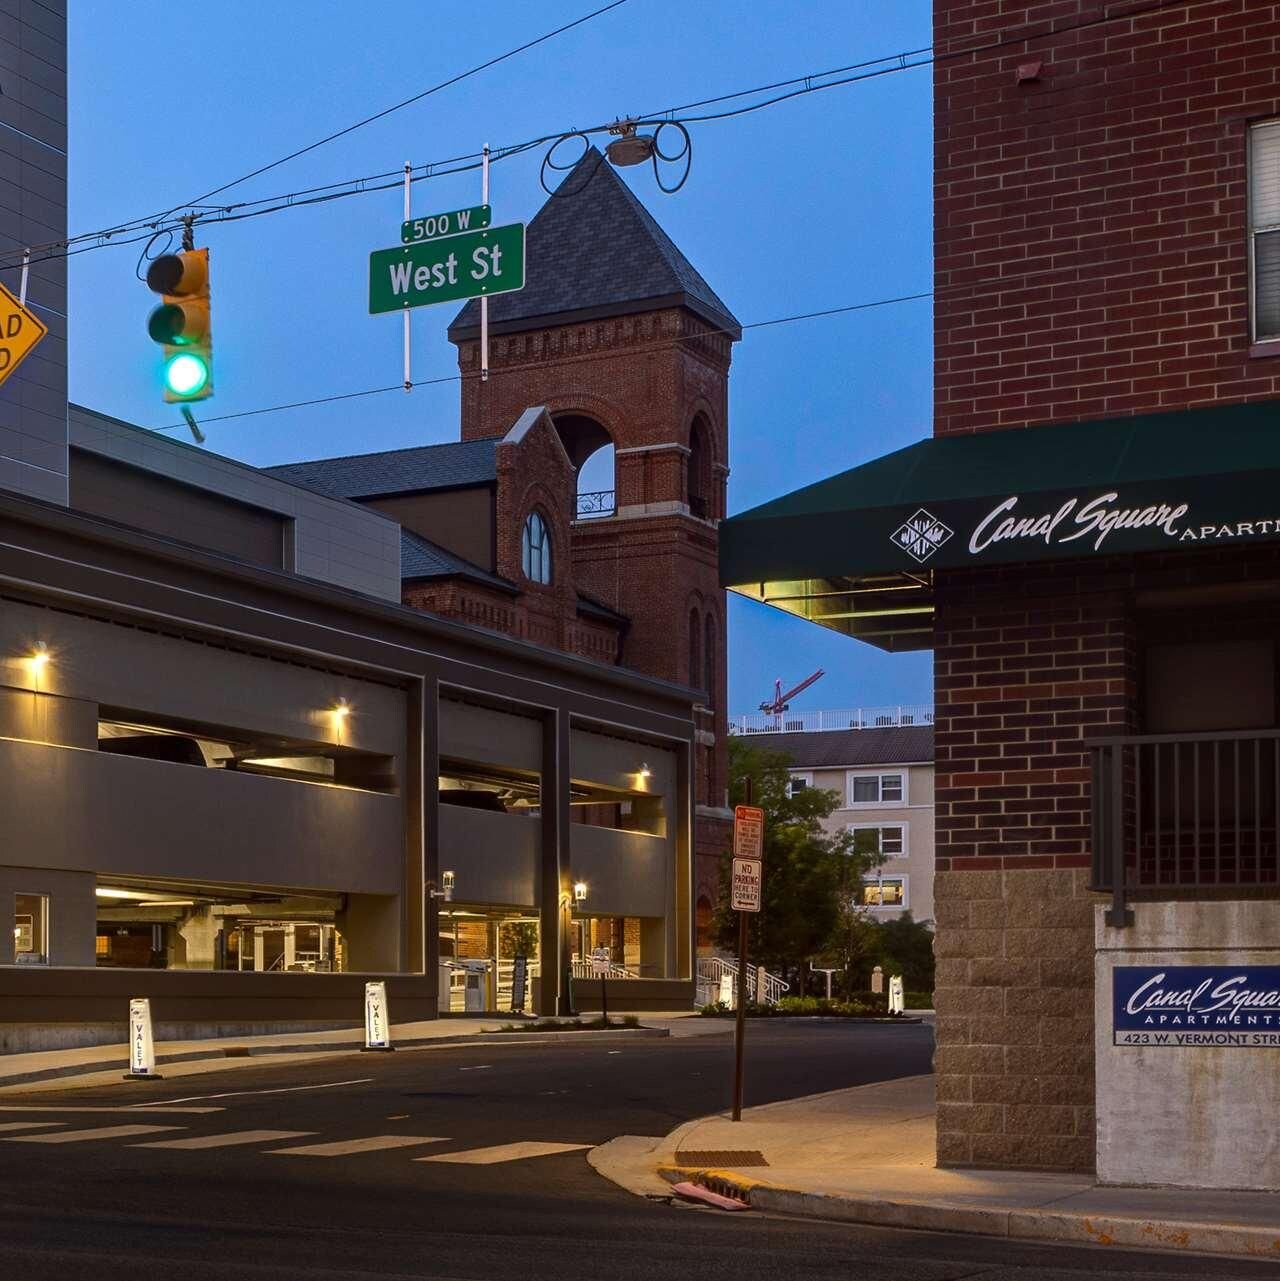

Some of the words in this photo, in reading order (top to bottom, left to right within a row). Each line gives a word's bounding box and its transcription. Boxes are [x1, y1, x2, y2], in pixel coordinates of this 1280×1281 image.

[413, 215, 449, 239] 500
[457, 210, 471, 230] W
[389, 252, 458, 296] West
[470, 243, 502, 280] St
[968, 496, 1078, 554] Canal
[1058, 492, 1188, 551] Square
[735, 874, 759, 886] PARKING
[741, 864, 753, 875] NO
[1126, 972, 1214, 1015] Canal
[1196, 975, 1280, 1021] Squa
[372, 1004, 380, 1041] VALET
[1144, 1015, 1280, 1025] APARTMENT
[1124, 1033, 1150, 1044] 423
[1154, 1033, 1171, 1044] W.
[1175, 1033, 1249, 1045] VERMONT
[1252, 1033, 1280, 1045] STR
